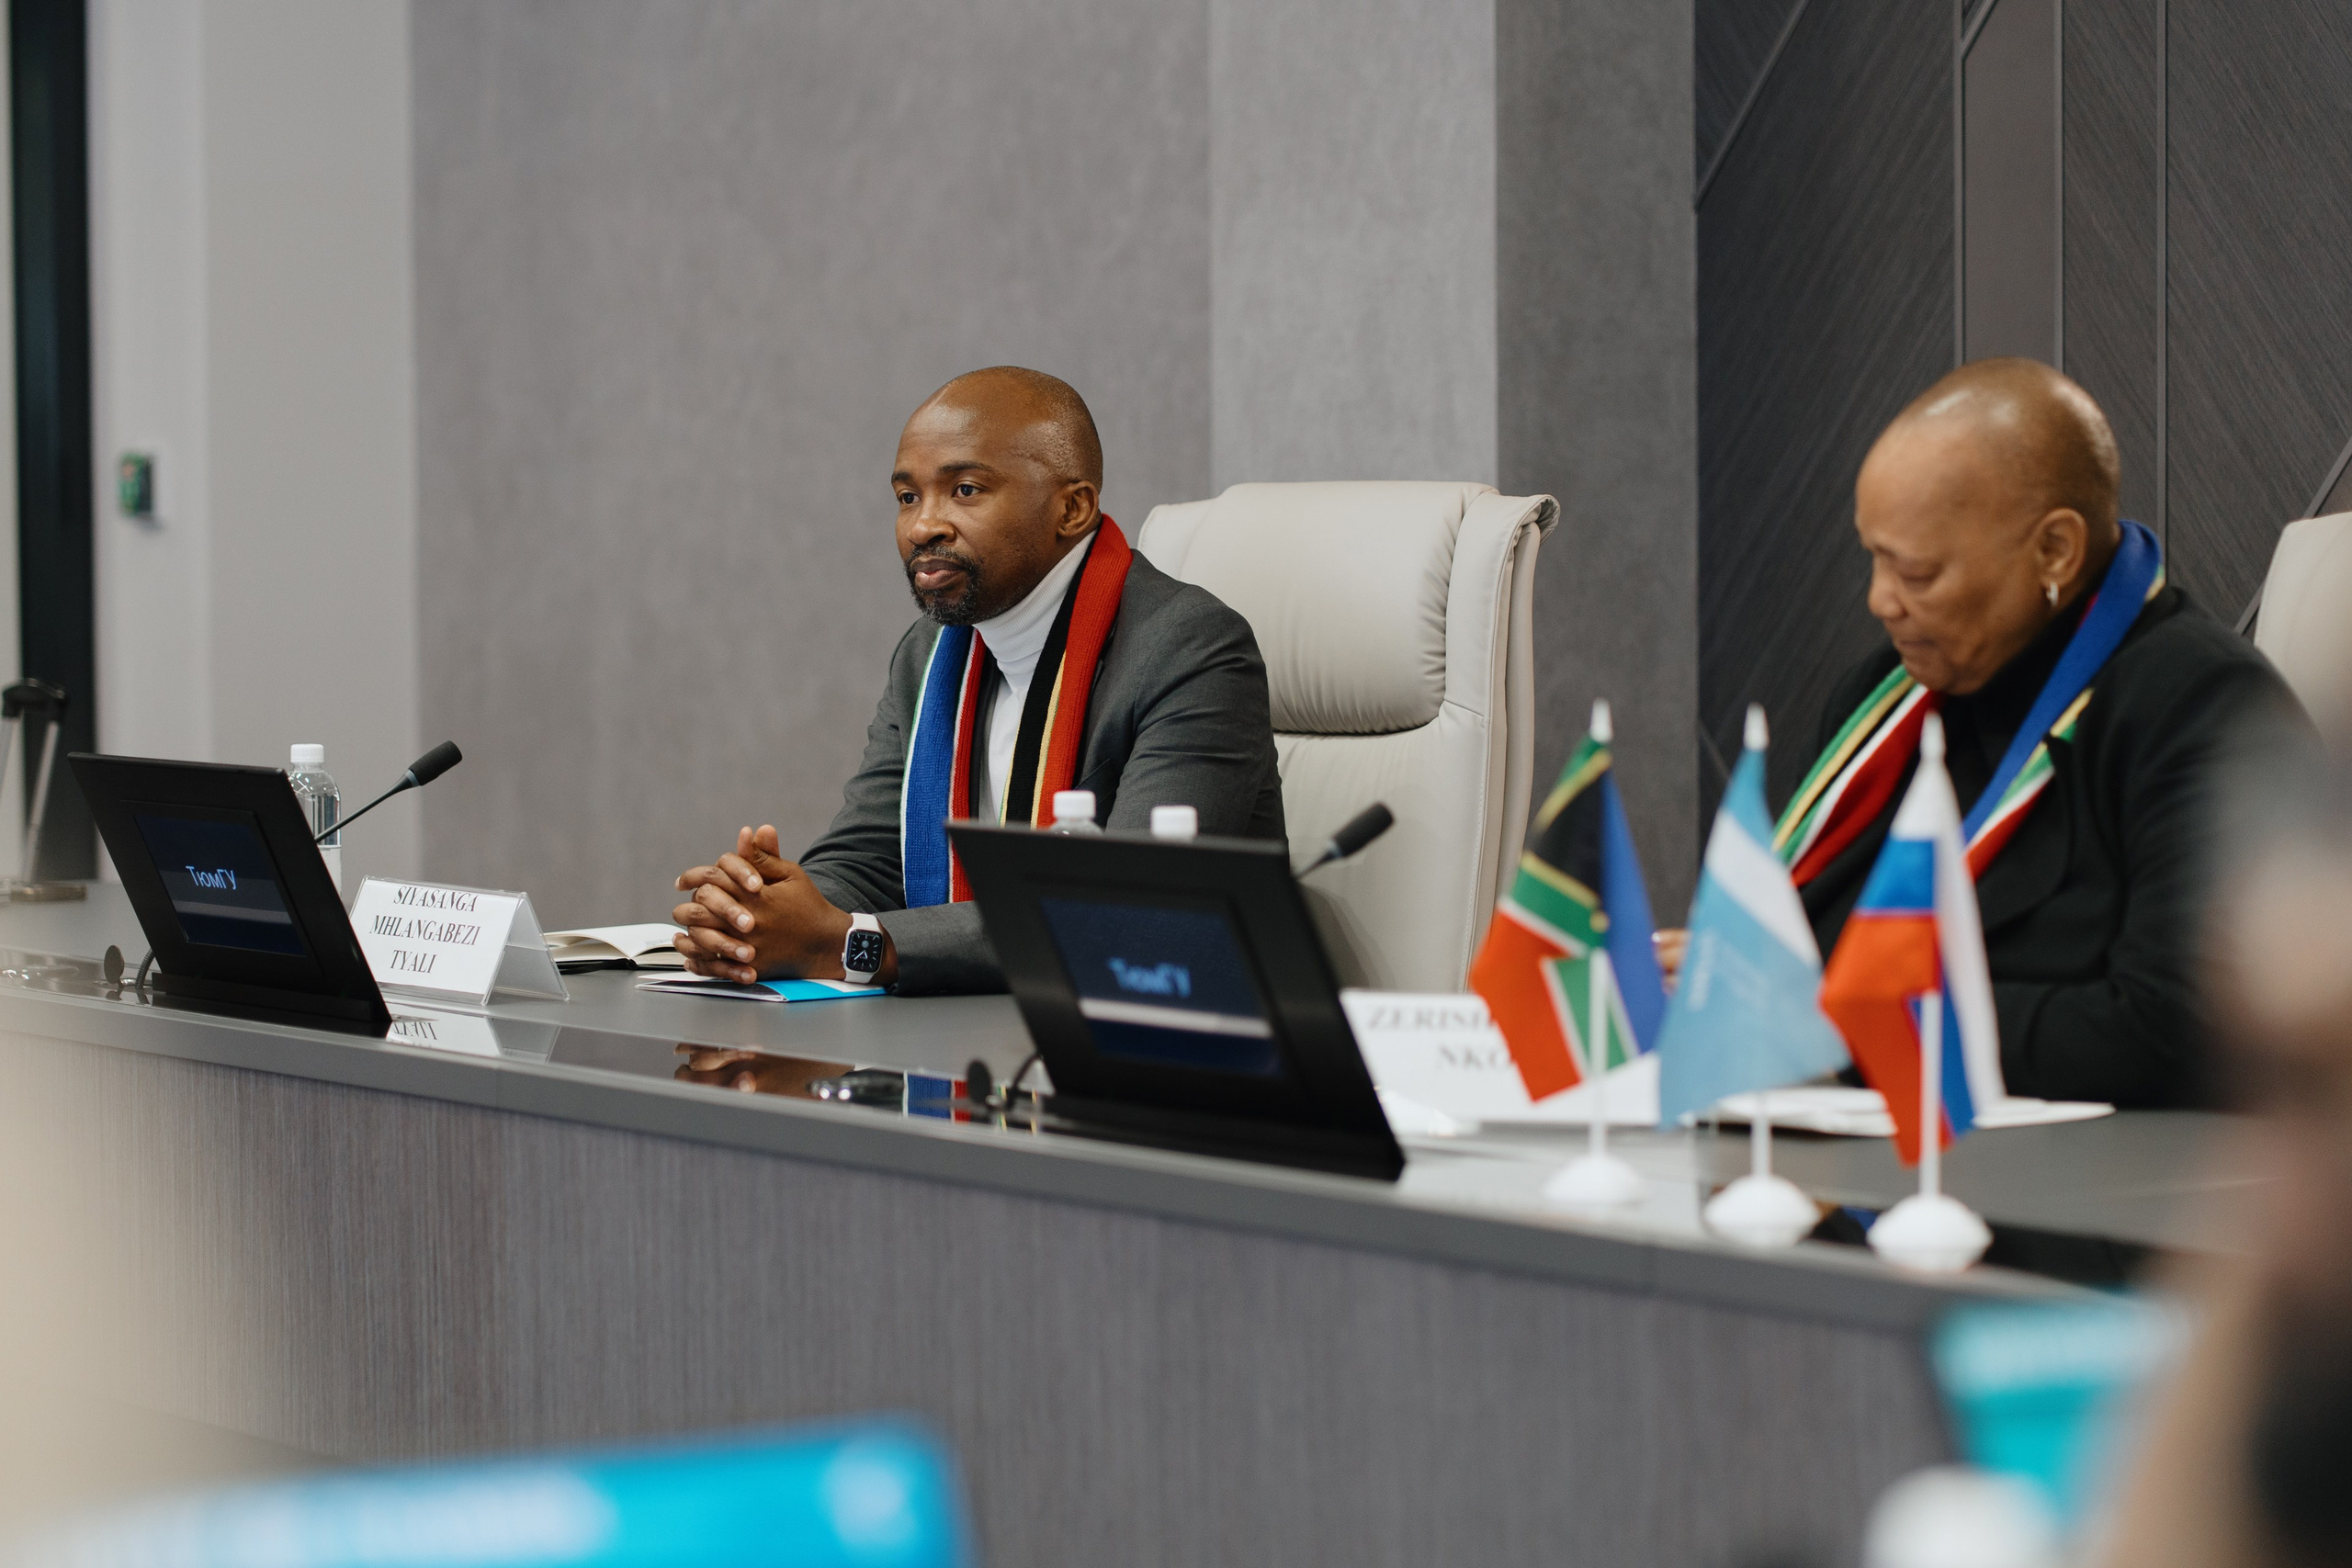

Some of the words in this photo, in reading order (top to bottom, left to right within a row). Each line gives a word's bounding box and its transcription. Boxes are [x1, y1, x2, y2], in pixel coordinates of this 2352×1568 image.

[186, 865, 237, 890] ТюмГУ
[393, 886, 479, 912] SIYASANGA
[368, 915, 481, 945] MHLANGABEZI
[390, 950, 437, 974] TYALI
